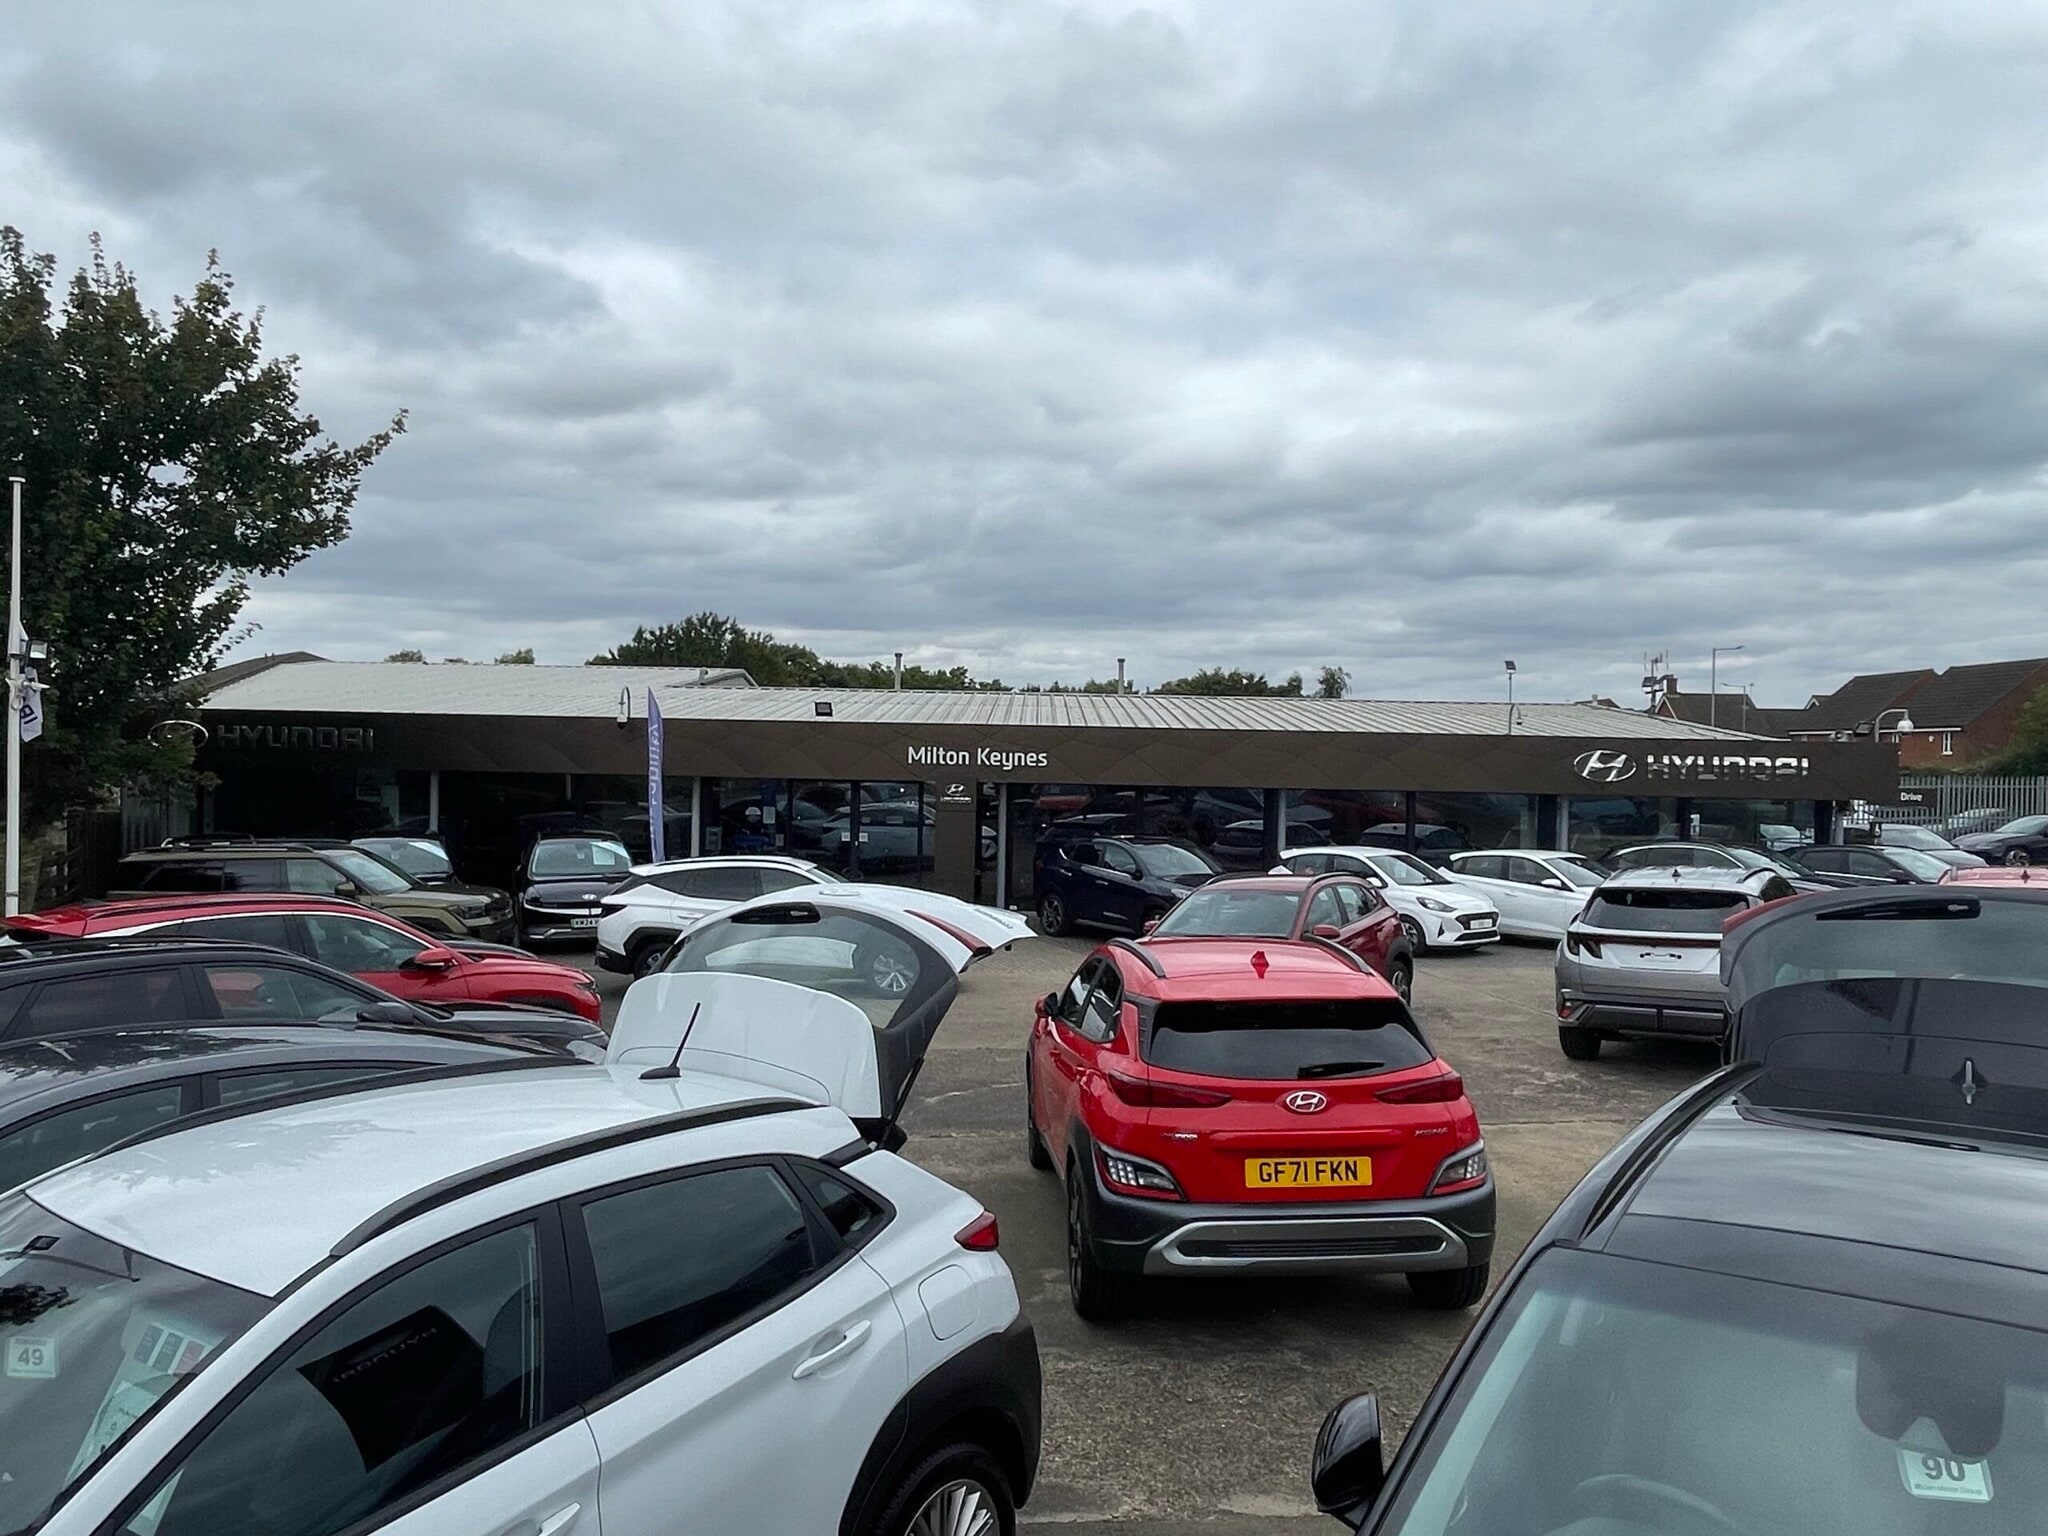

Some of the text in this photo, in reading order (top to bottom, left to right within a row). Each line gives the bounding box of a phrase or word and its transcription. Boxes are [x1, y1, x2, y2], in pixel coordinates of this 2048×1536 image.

[217, 725, 374, 751] HYUNDAI
[908, 746, 1048, 770] Milton Keynes
[1646, 754, 1809, 781] HYUNDAI
[1900, 792, 1923, 802] Drive
[1258, 1159, 1358, 1183] GF71 FKN
[17, 1347, 44, 1366] 49
[1921, 1451, 1966, 1482] 90
